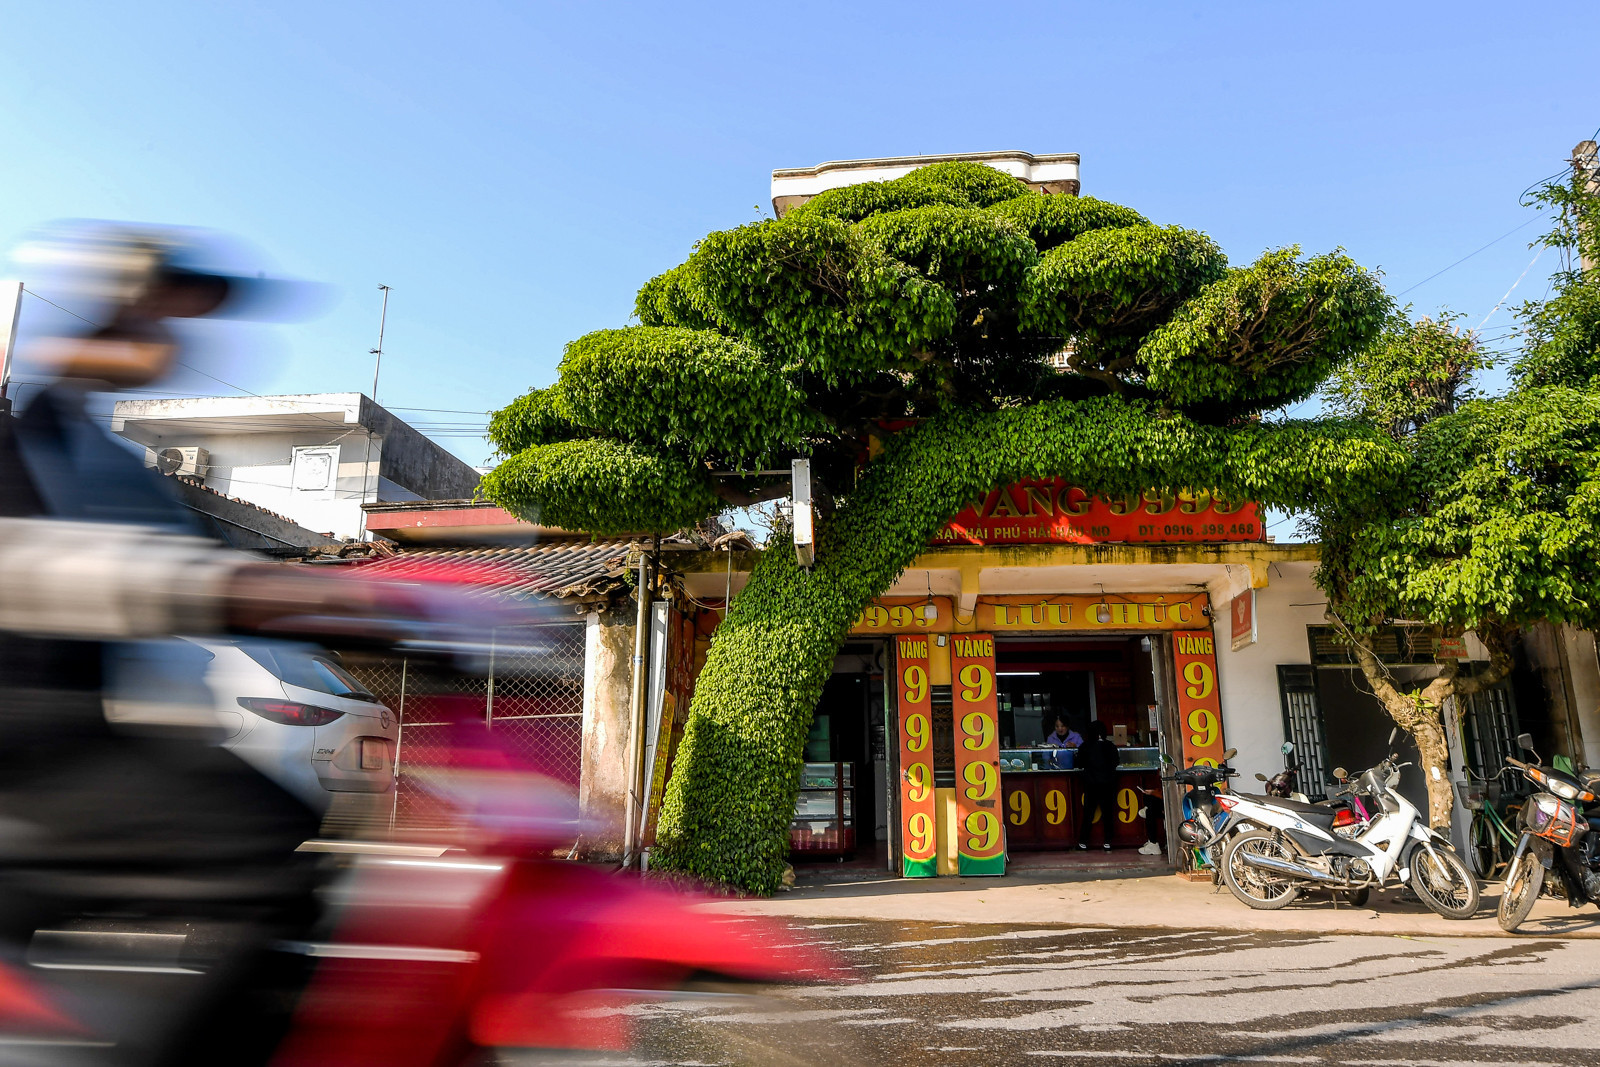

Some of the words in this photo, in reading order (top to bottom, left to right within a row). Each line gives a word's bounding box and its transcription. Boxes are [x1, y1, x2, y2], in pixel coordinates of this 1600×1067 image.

[854, 604, 939, 628] 999
[994, 599, 1074, 626] LƯU
[1084, 595, 1194, 626] CHÚC
[899, 637, 928, 659] VÀNG
[954, 636, 993, 658] VÀNG
[1177, 633, 1213, 656] VÀNG
